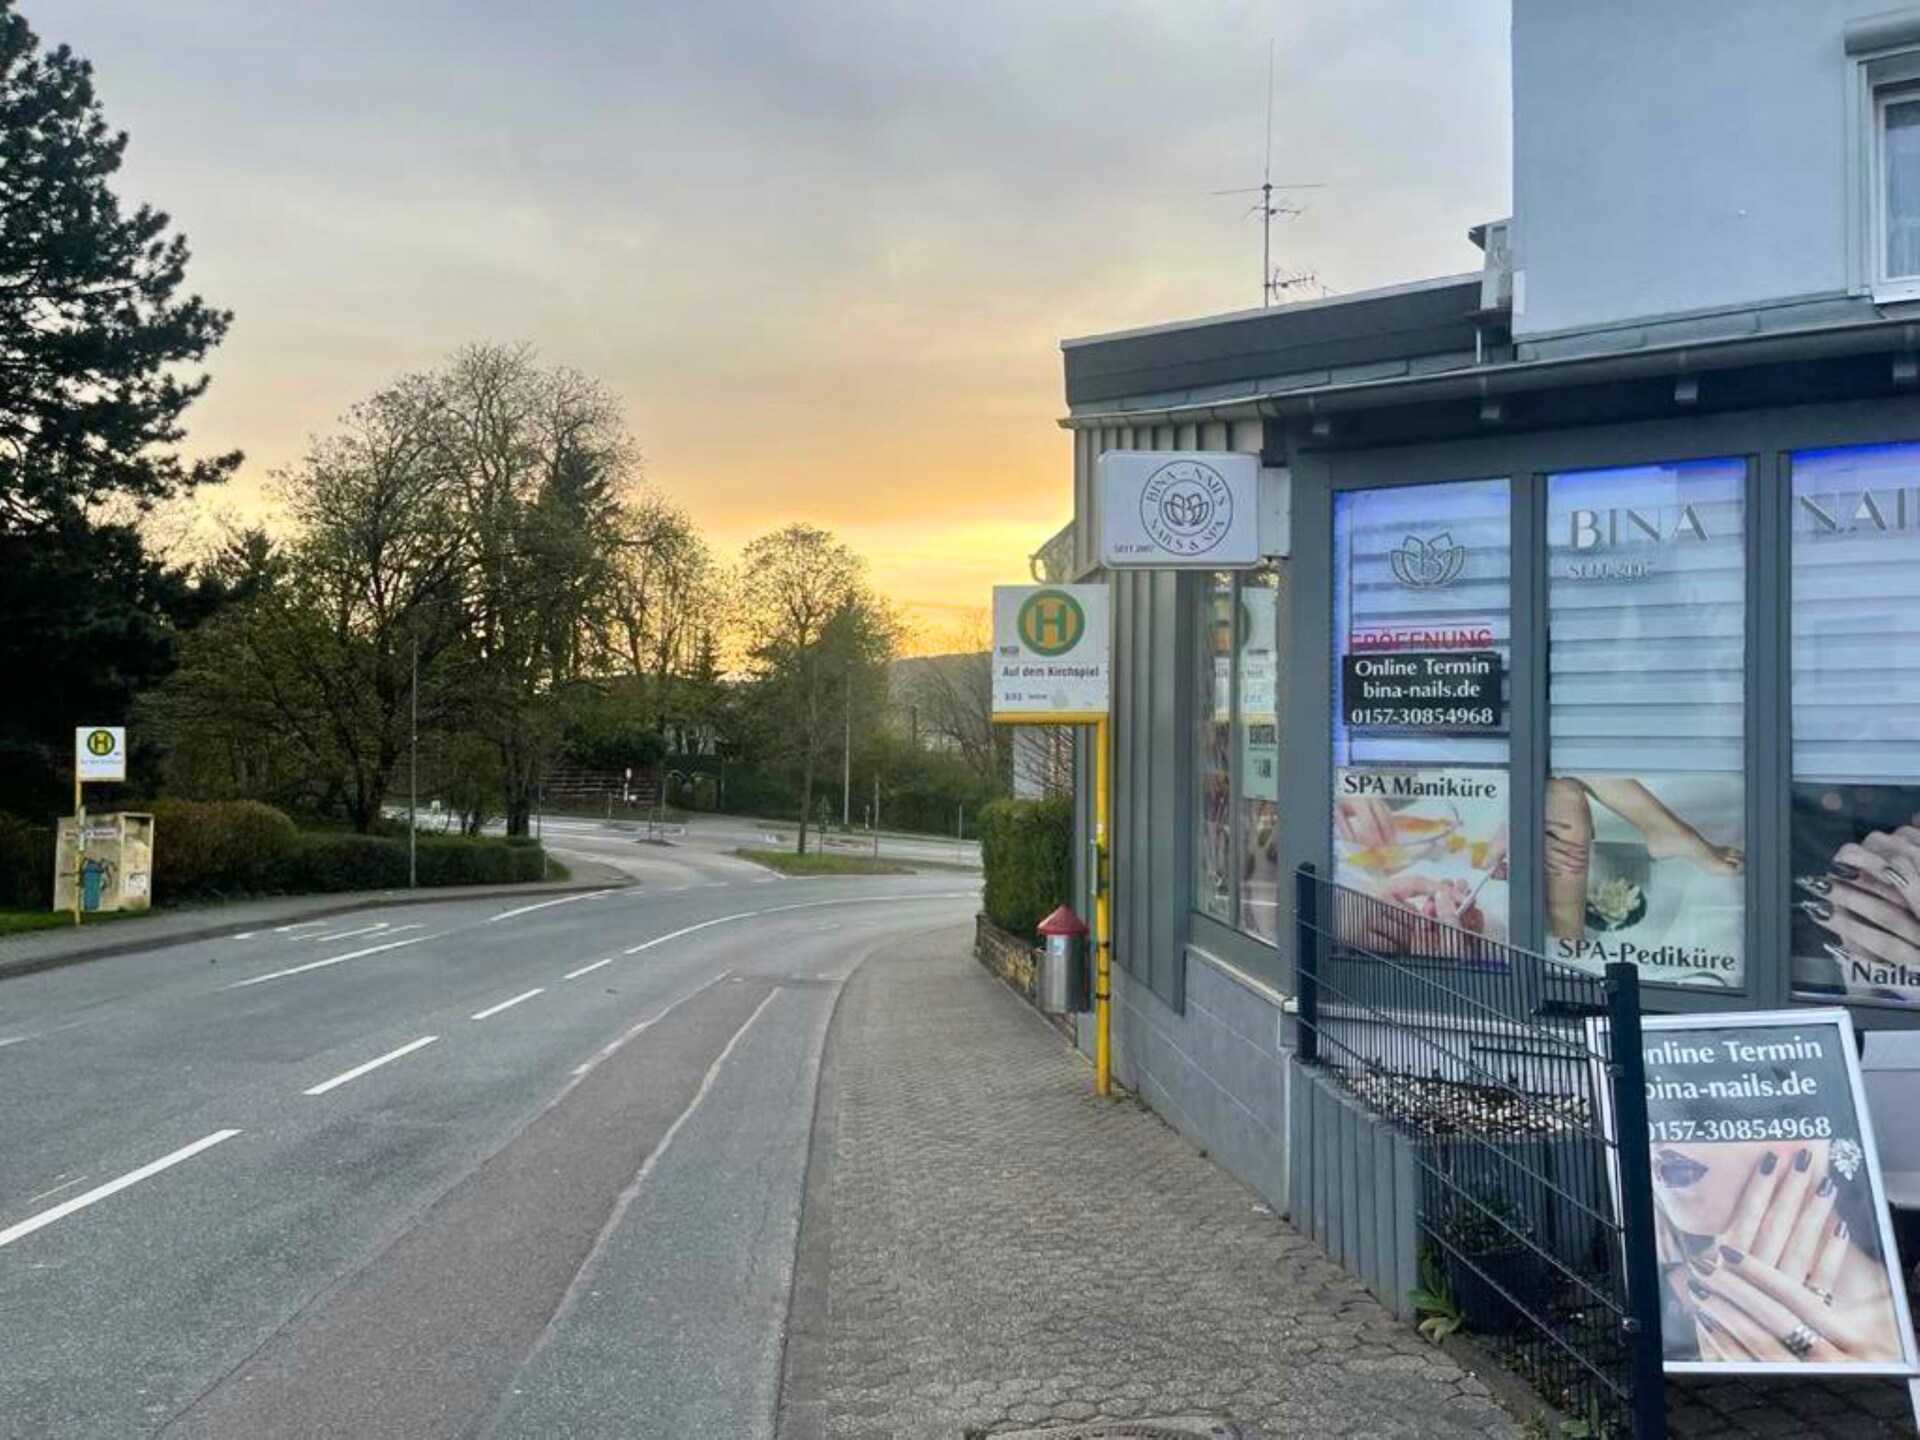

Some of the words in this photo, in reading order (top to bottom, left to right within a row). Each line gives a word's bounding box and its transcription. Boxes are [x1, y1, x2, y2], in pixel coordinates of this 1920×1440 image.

[1145, 470, 1176, 503] BINA
[1800, 487, 1920, 532] NAI
[1202, 520, 1226, 542] SPA
[1571, 504, 1708, 549] BINA
[1035, 601, 1067, 643] H
[1002, 665, 1020, 677] Auf
[1022, 665, 1044, 677] dem
[1047, 664, 1099, 680] Kirchspiel
[1355, 658, 1417, 676] Online
[1424, 657, 1490, 675] Termin
[1363, 679, 1481, 699] bina-nails.de
[1352, 707, 1493, 724] 0157-30854968
[94, 734, 108, 751] H
[1344, 775, 1387, 794] SPA
[1393, 777, 1498, 798] Maniküre
[1558, 938, 1737, 972] SPA-Pediküre
[1644, 1040, 1715, 1065] nline
[1722, 1035, 1823, 1063] Termin
